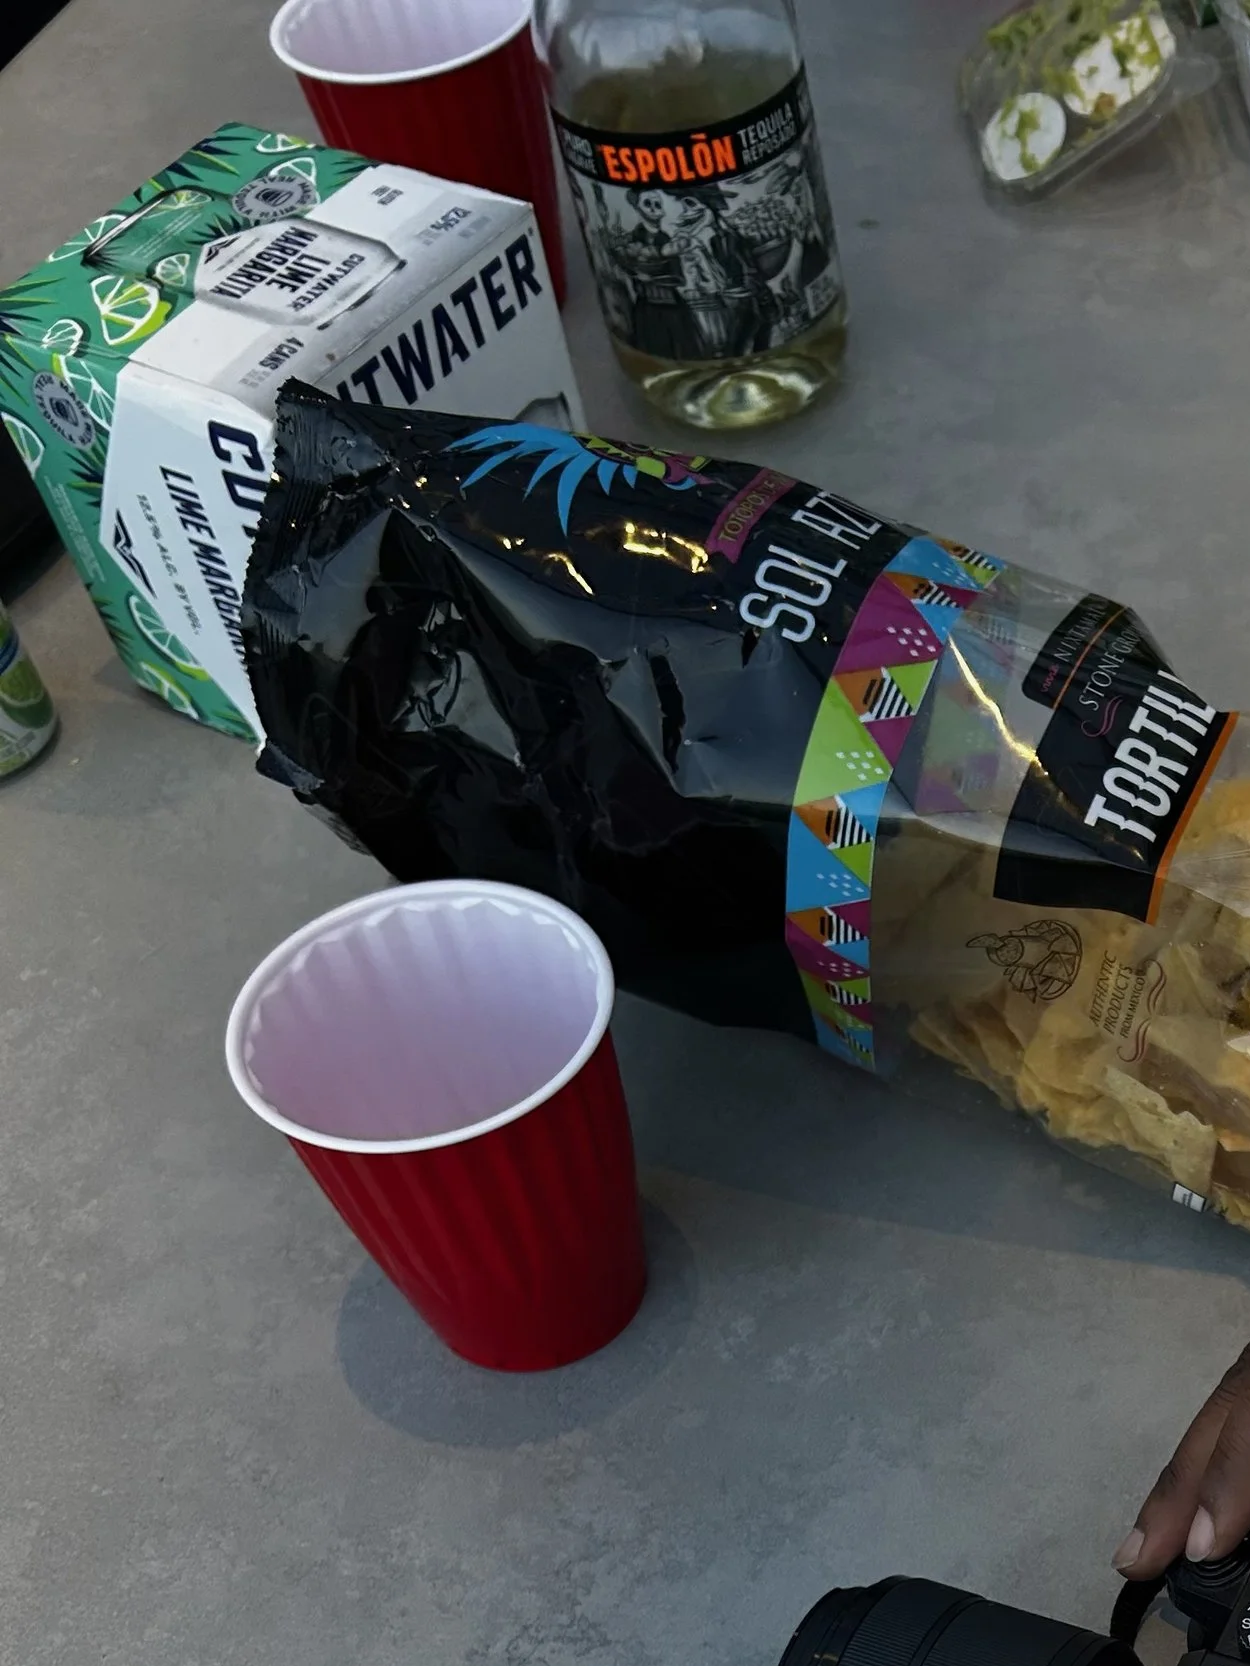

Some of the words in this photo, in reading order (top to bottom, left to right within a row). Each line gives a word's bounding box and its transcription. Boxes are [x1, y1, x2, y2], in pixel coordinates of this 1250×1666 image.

[737, 101, 794, 148] TEQUILA
[209, 226, 319, 299] MARGARITA
[265, 254, 331, 293] LIME
[287, 253, 365, 312] CUTWATER
[337, 234, 543, 406] TWATER
[258, 338, 298, 371] CANS
[159, 465, 217, 541] LIME
[207, 419, 268, 540] CU
[739, 544, 848, 644] SOL
[1078, 647, 1126, 712] STONE
[1088, 950, 1118, 1027] AUTHENTIC
[1102, 964, 1134, 1036] PRODUCTS
[1126, 975, 1147, 1013] MEXICO
[1118, 1007, 1137, 1039] FROM
